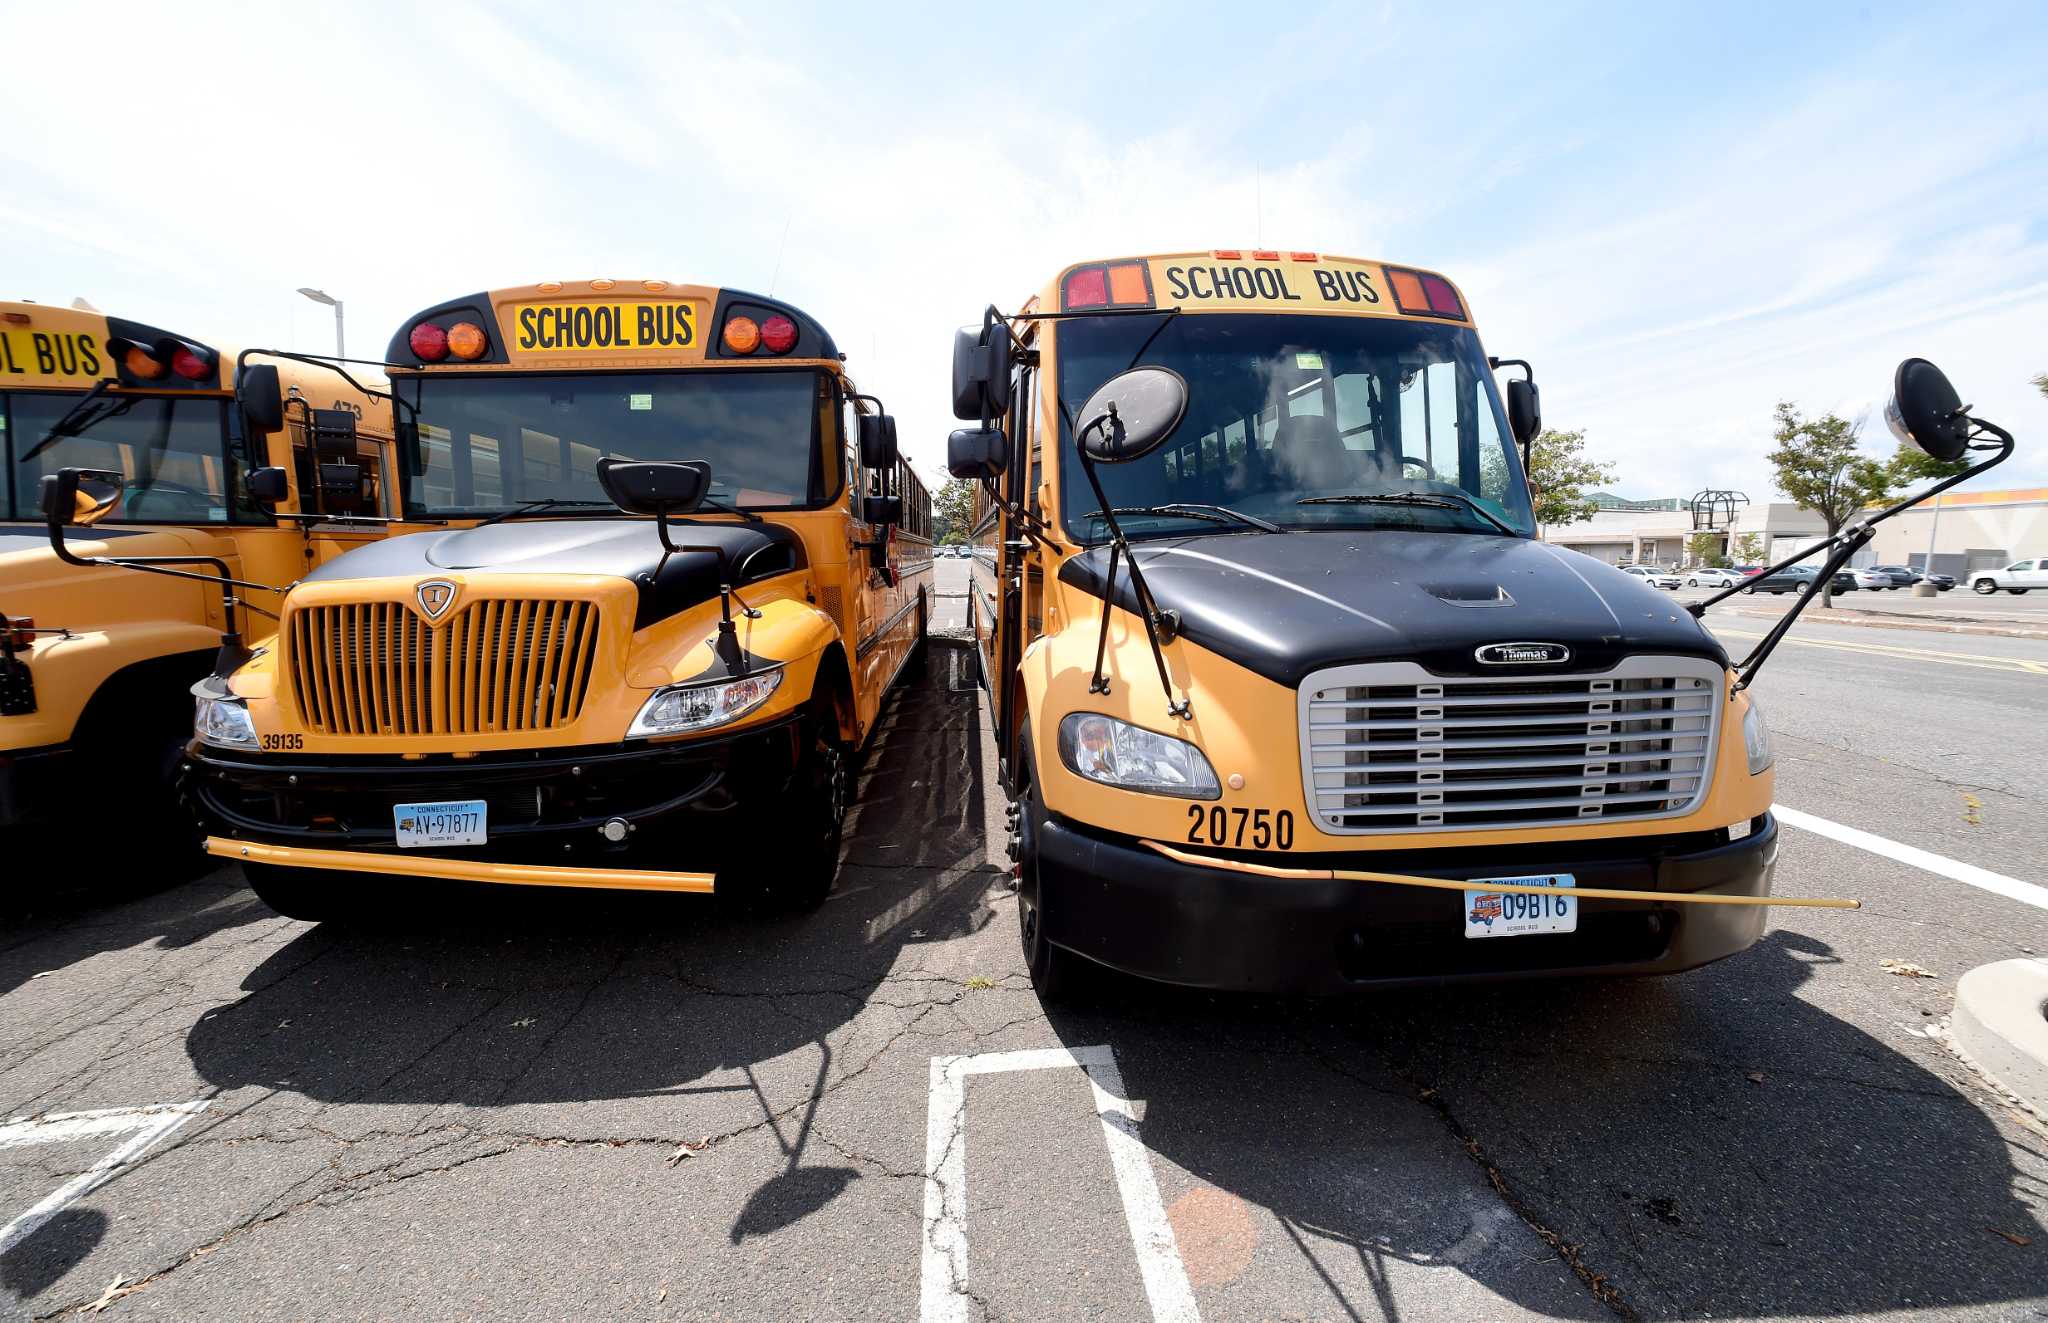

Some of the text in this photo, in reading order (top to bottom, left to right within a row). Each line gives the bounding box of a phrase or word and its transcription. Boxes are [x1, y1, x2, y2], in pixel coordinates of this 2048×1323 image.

[1166, 266, 1380, 304] SCHOOL BUS
[519, 304, 693, 349] SCHOOL BUS
[0, 331, 100, 377] L BUS
[1495, 646, 1551, 661] Thomas
[262, 733, 303, 750] 39135
[417, 804, 464, 813] CONNECTICUT
[1187, 803, 1294, 850] 20750
